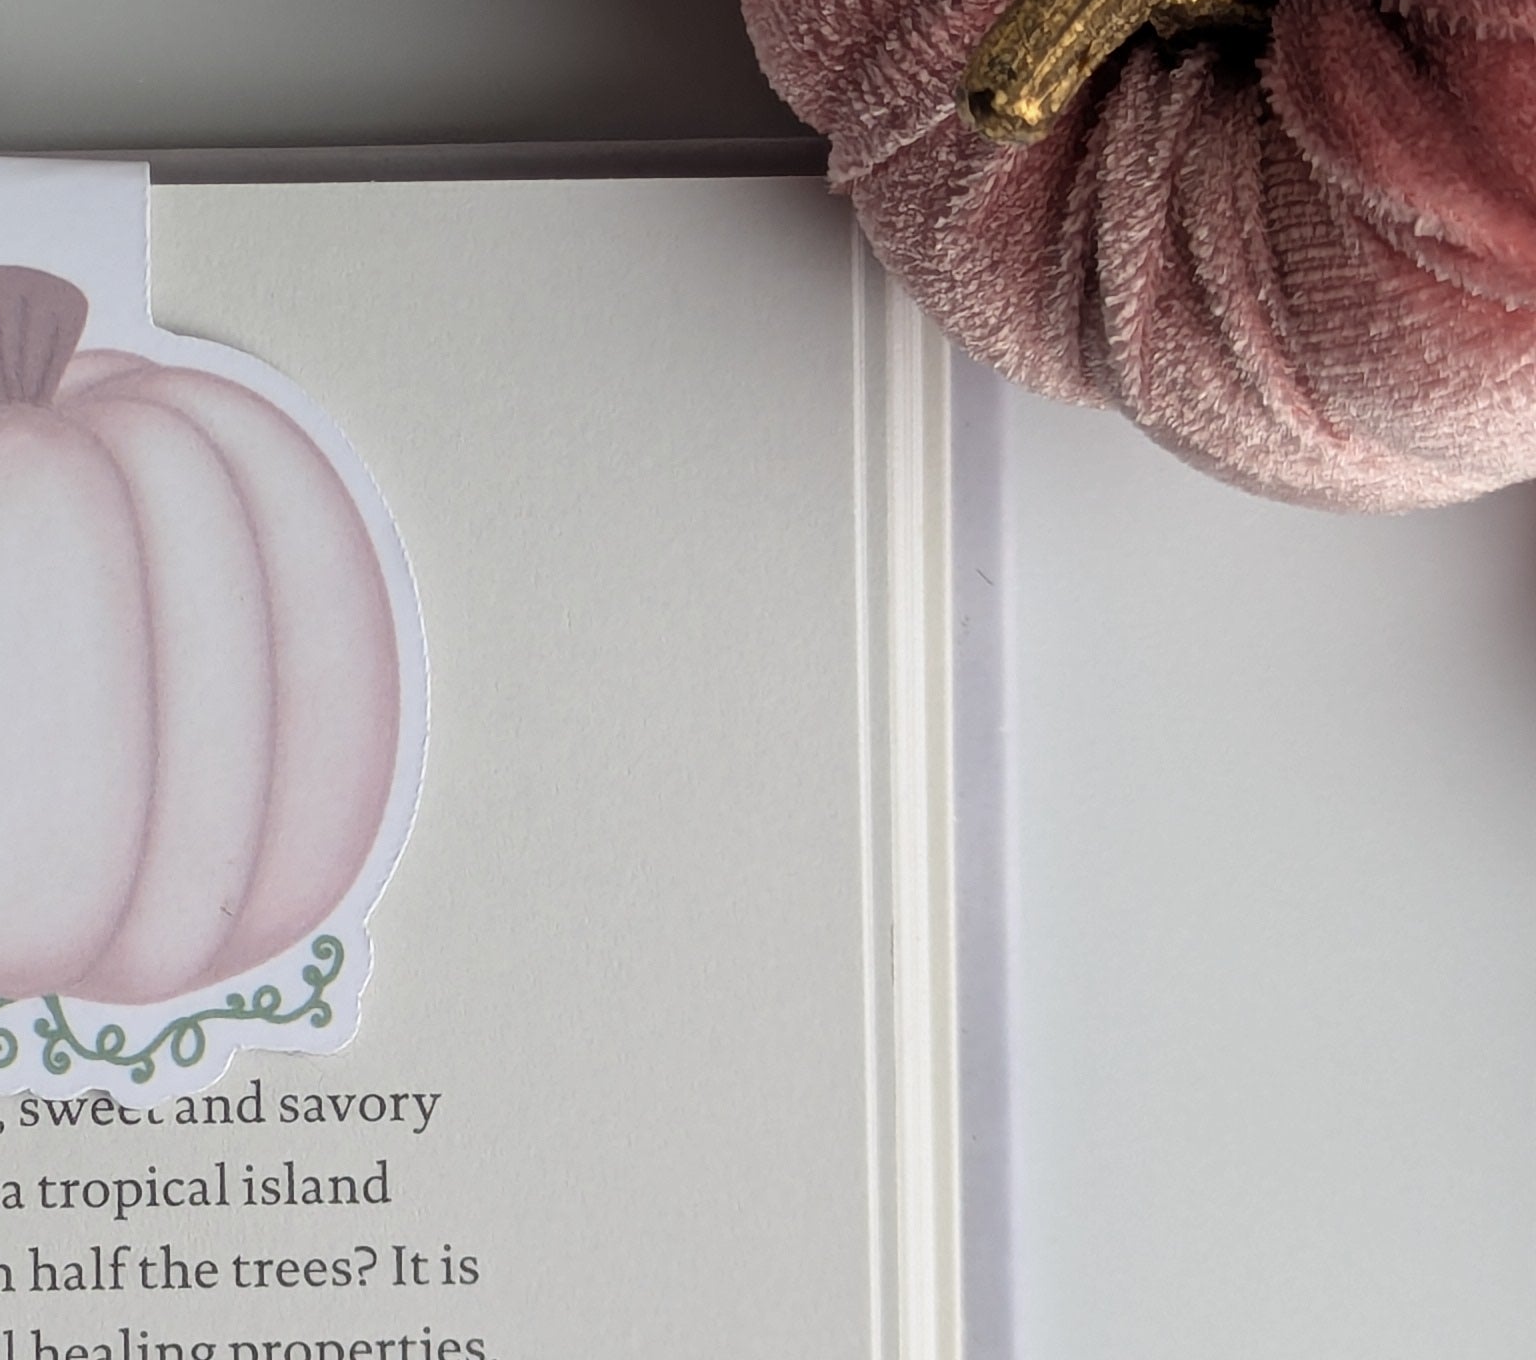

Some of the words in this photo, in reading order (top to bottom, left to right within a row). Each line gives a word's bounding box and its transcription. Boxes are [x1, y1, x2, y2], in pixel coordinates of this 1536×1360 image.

[176, 1079, 266, 1124] and
[280, 1093, 441, 1134] savory
[2, 1181, 25, 1209] a
[38, 1161, 230, 1221] tropical
[242, 1159, 392, 1205] island
